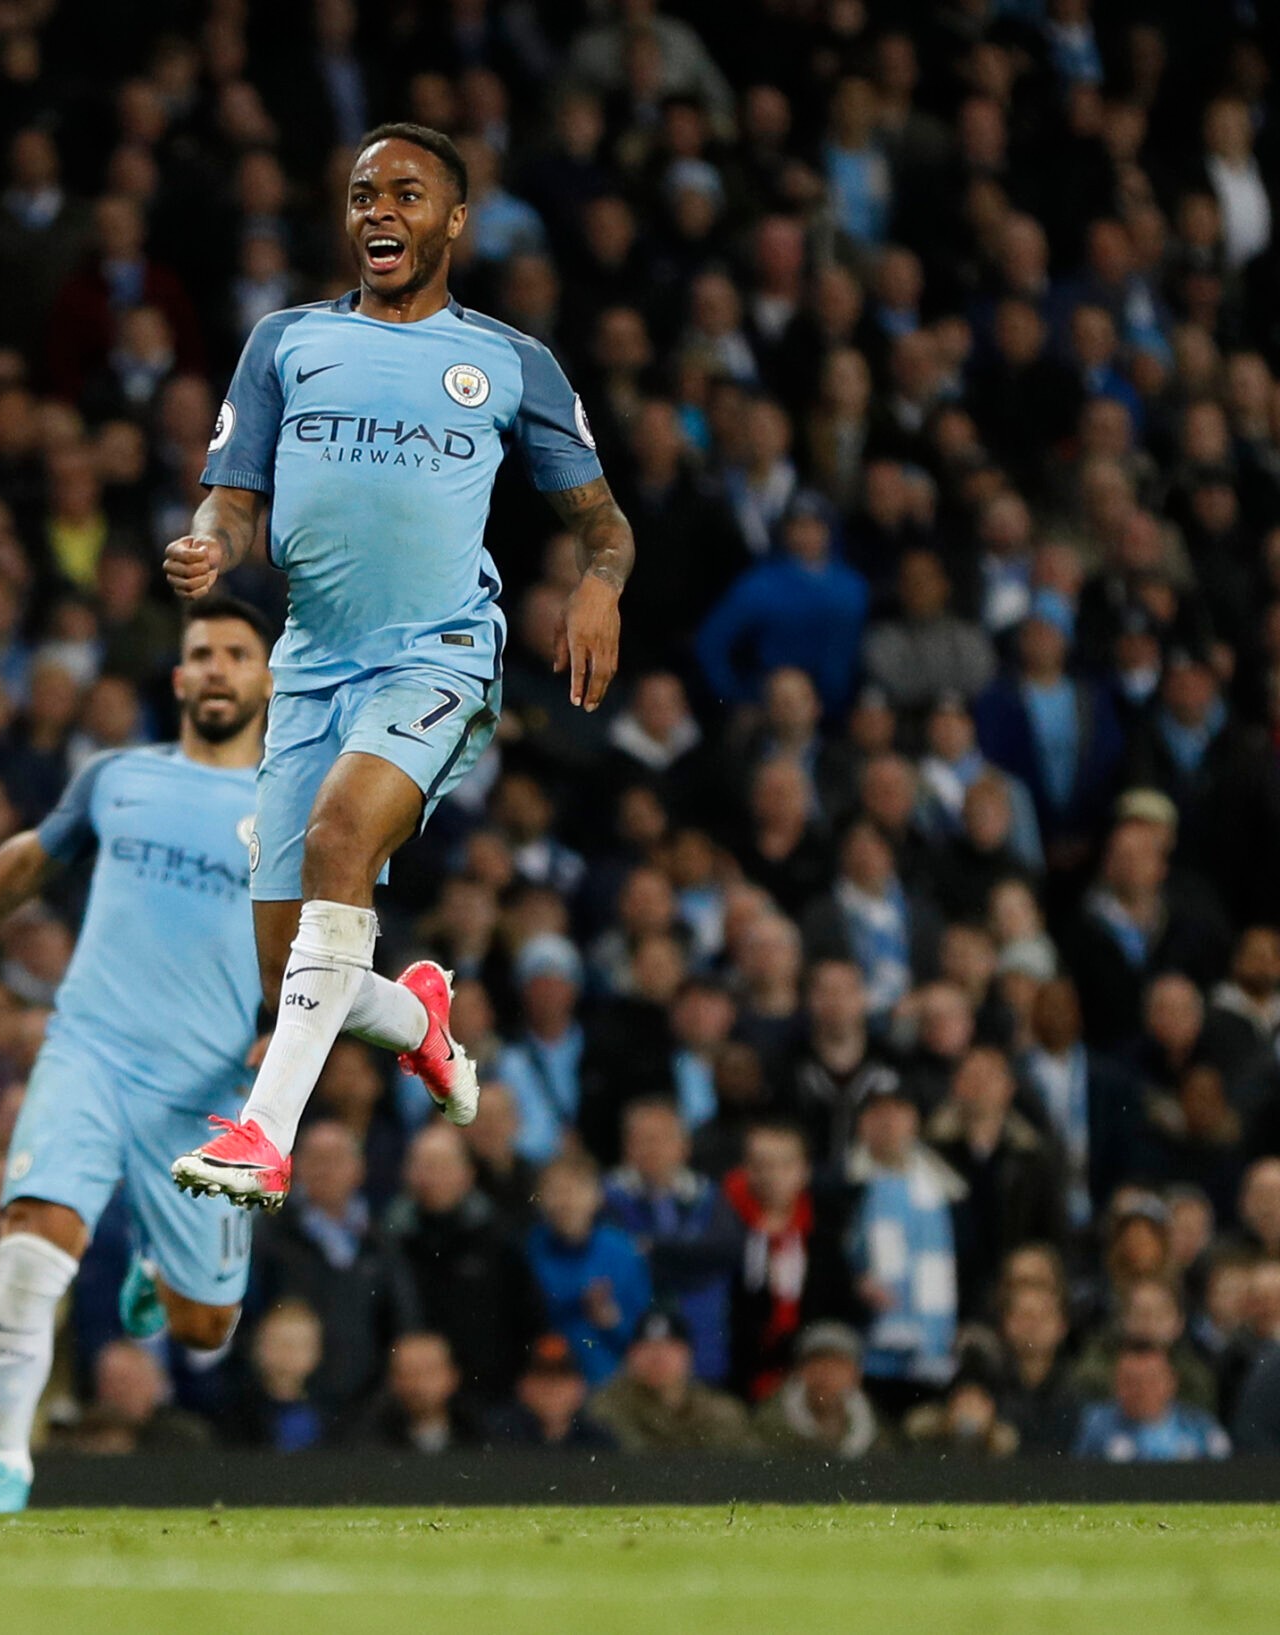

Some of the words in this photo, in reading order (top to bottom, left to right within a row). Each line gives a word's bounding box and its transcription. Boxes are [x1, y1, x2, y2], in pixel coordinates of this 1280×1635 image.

[296, 416, 475, 461] ETIHAD
[320, 447, 441, 473] AIRWAYS
[410, 687, 463, 735] 7
[285, 993, 320, 1011] city
